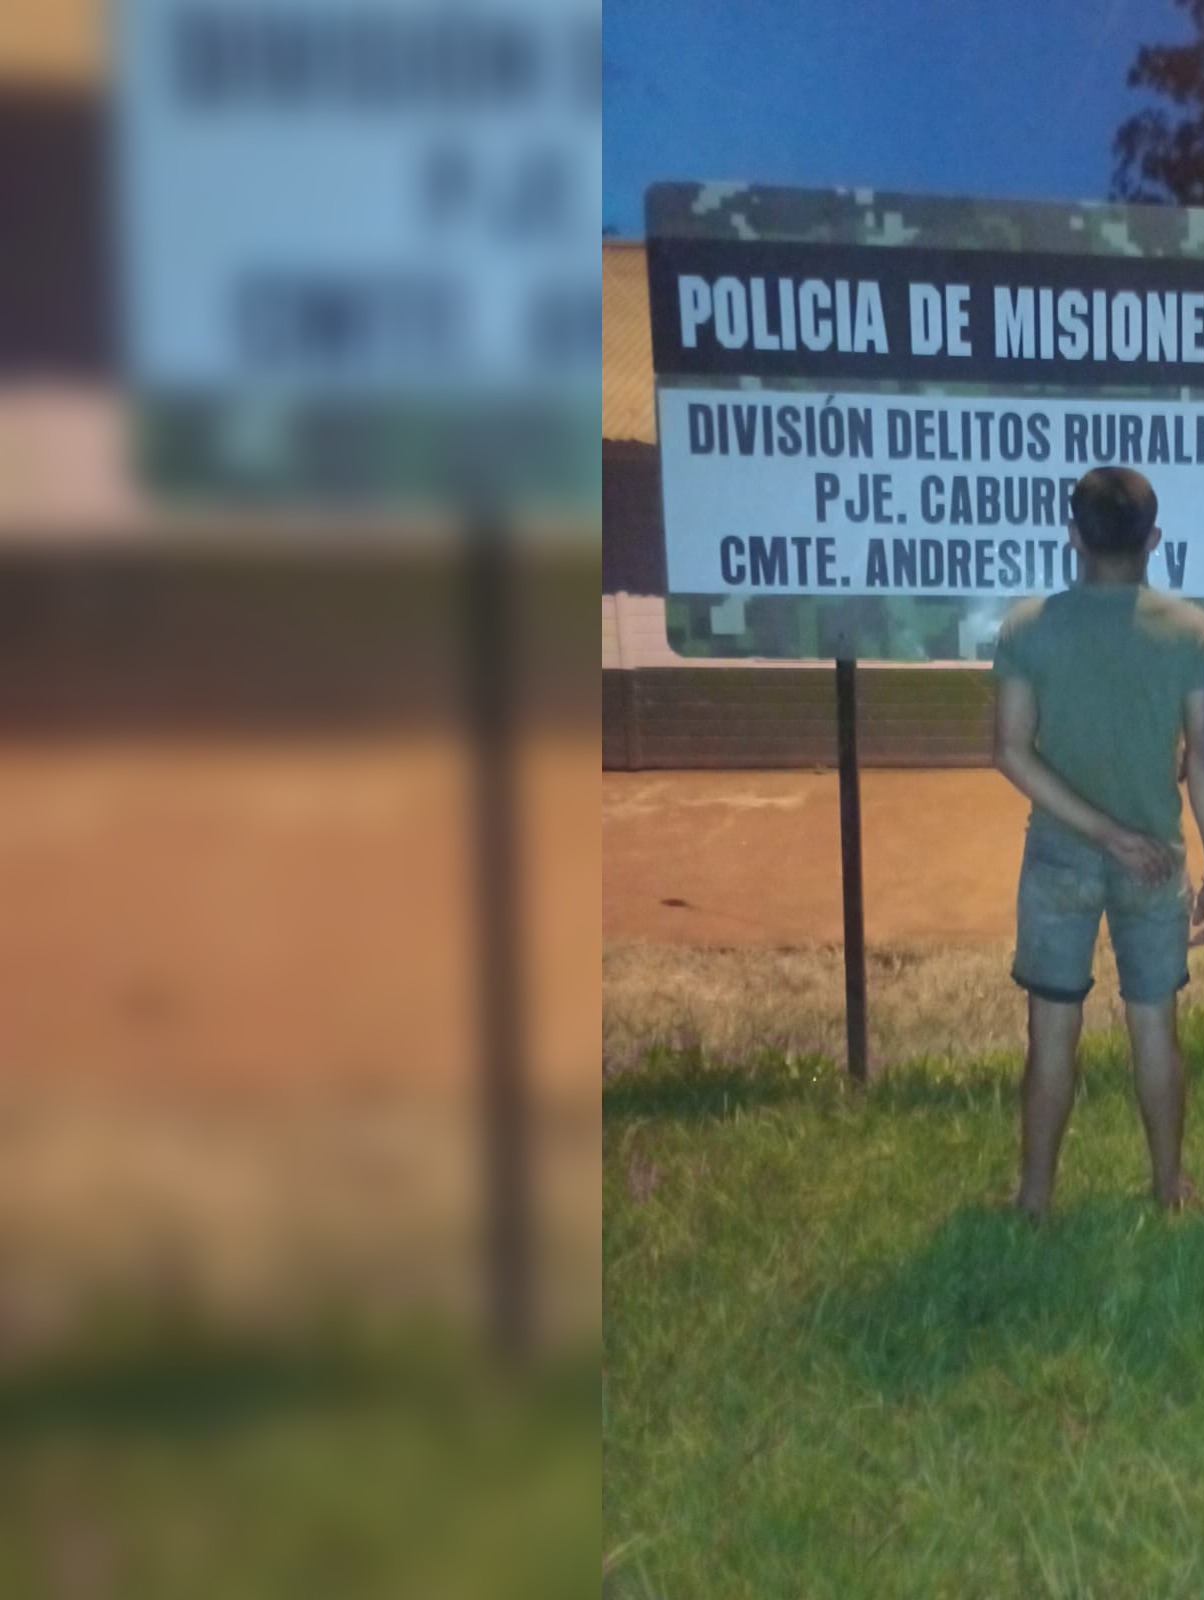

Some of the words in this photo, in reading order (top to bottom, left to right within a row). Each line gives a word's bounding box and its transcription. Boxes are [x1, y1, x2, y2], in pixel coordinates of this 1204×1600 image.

[678, 274, 889, 354] POLICIA
[909, 282, 972, 357] DE
[688, 393, 873, 458] DIVISIÓN
[887, 408, 1051, 462] DELITOS
[815, 472, 907, 524] PJE.
[720, 535, 850, 587] CMTE.
[866, 537, 1080, 589] ANDRESITO
